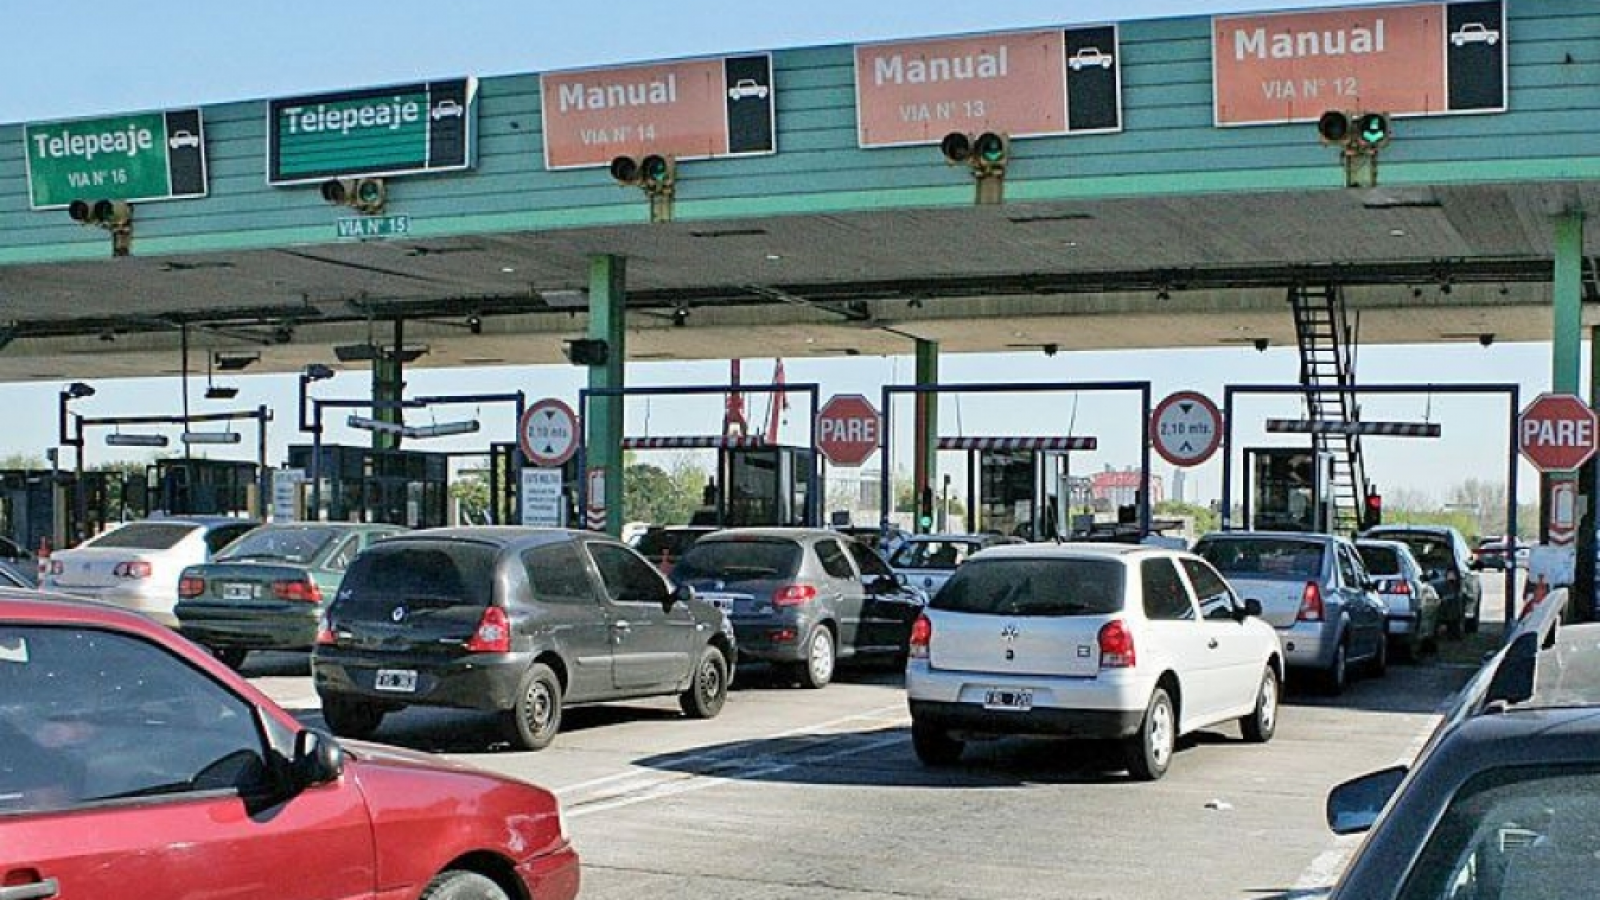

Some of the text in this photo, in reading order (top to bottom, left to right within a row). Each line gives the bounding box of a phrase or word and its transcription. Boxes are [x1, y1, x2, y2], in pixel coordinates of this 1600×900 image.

[1234, 18, 1385, 61] Manual
[874, 44, 1008, 86] Manual
[559, 73, 677, 113] Manual
[1261, 80, 1296, 99] VIA
[1333, 76, 1359, 96] 12
[283, 96, 420, 135] Telepeaje
[899, 103, 931, 122] VIA
[962, 100, 986, 118] 13
[33, 123, 154, 161] Telepeaje
[580, 128, 610, 146] VIA
[638, 123, 656, 143] 14
[68, 171, 91, 188] VIA
[110, 168, 129, 185] 16
[338, 218, 364, 236] VIA
[391, 216, 408, 233] 15
[821, 418, 875, 442] PARE
[1523, 419, 1594, 447] PARE
